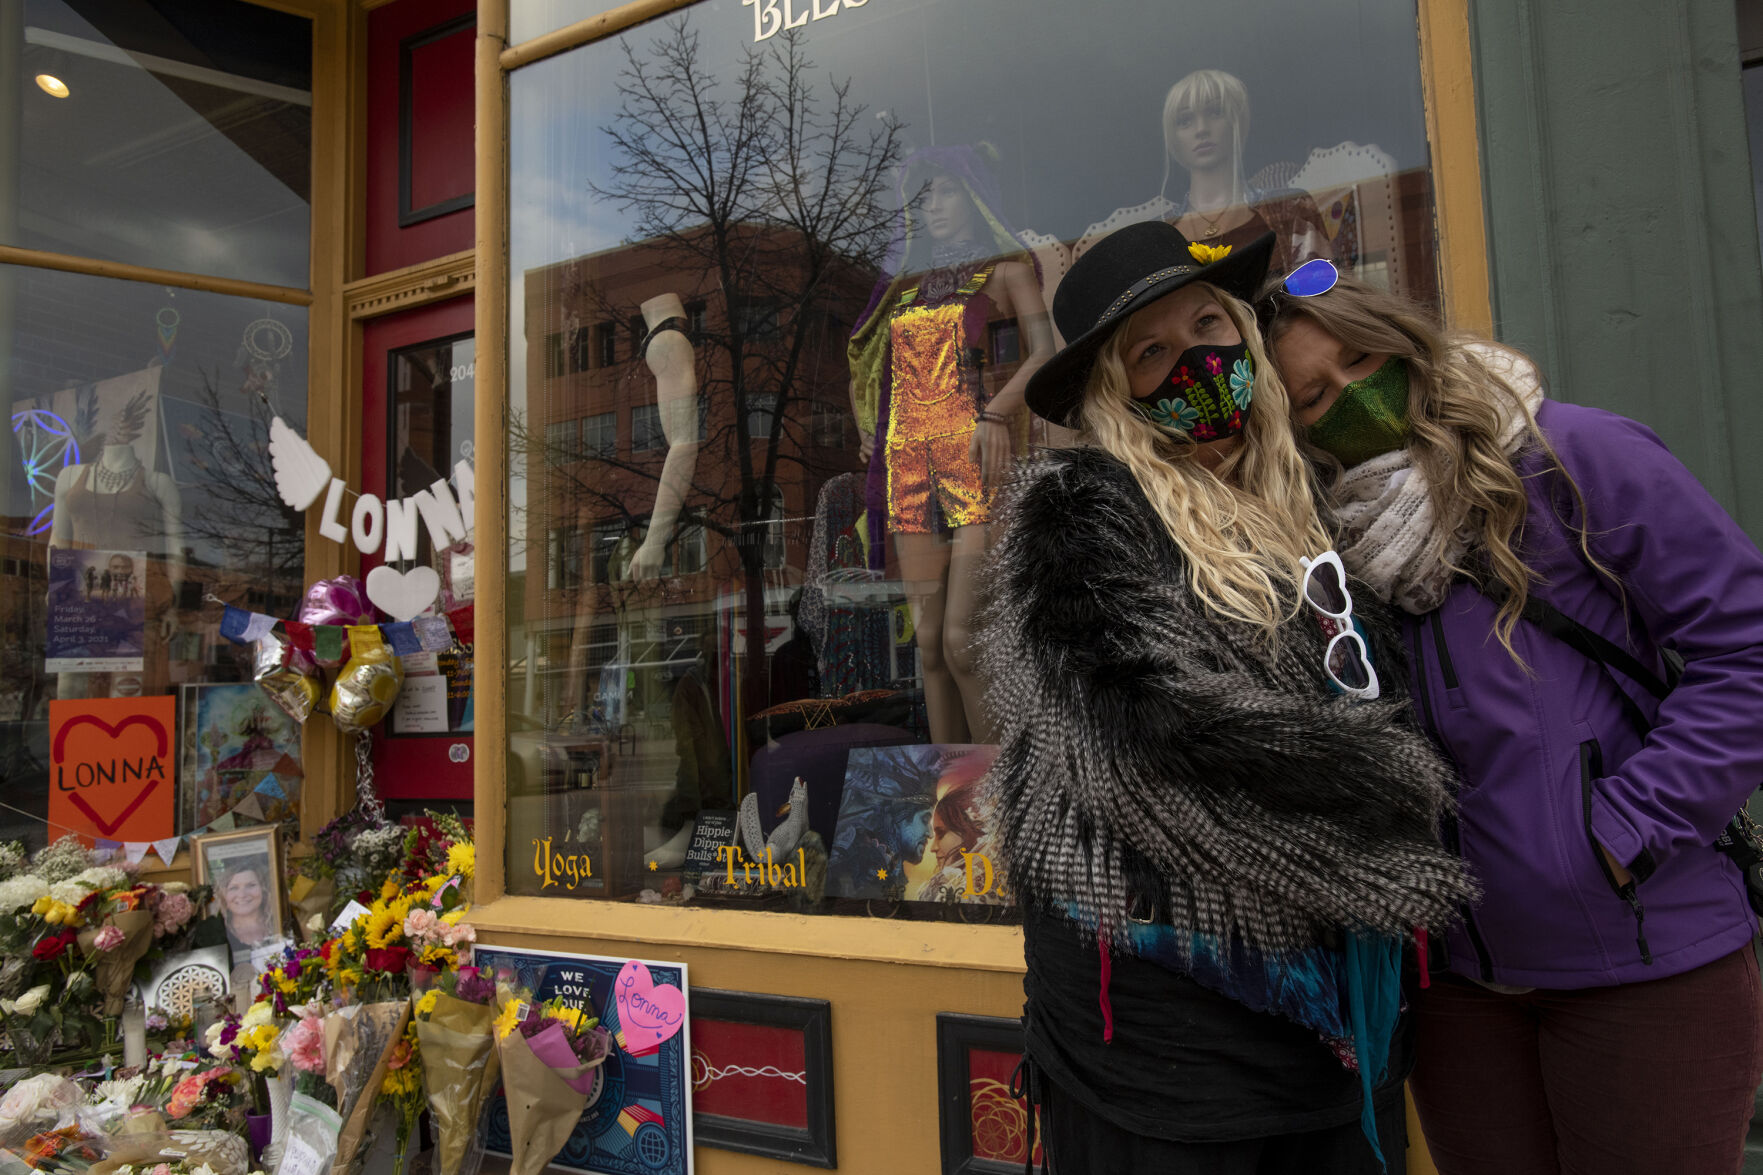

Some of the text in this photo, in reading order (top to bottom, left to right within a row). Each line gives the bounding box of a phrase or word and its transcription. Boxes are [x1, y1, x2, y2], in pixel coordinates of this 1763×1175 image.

[54, 615, 82, 624] March
[53, 635, 76, 644] April
[87, 635, 109, 643] 2021
[58, 755, 165, 791] LONNA
[532, 836, 592, 890] Yoga
[716, 845, 807, 889] Tribal
[560, 971, 584, 983] WE
[554, 985, 591, 999] LOVE
[619, 976, 682, 1029] Lonna
